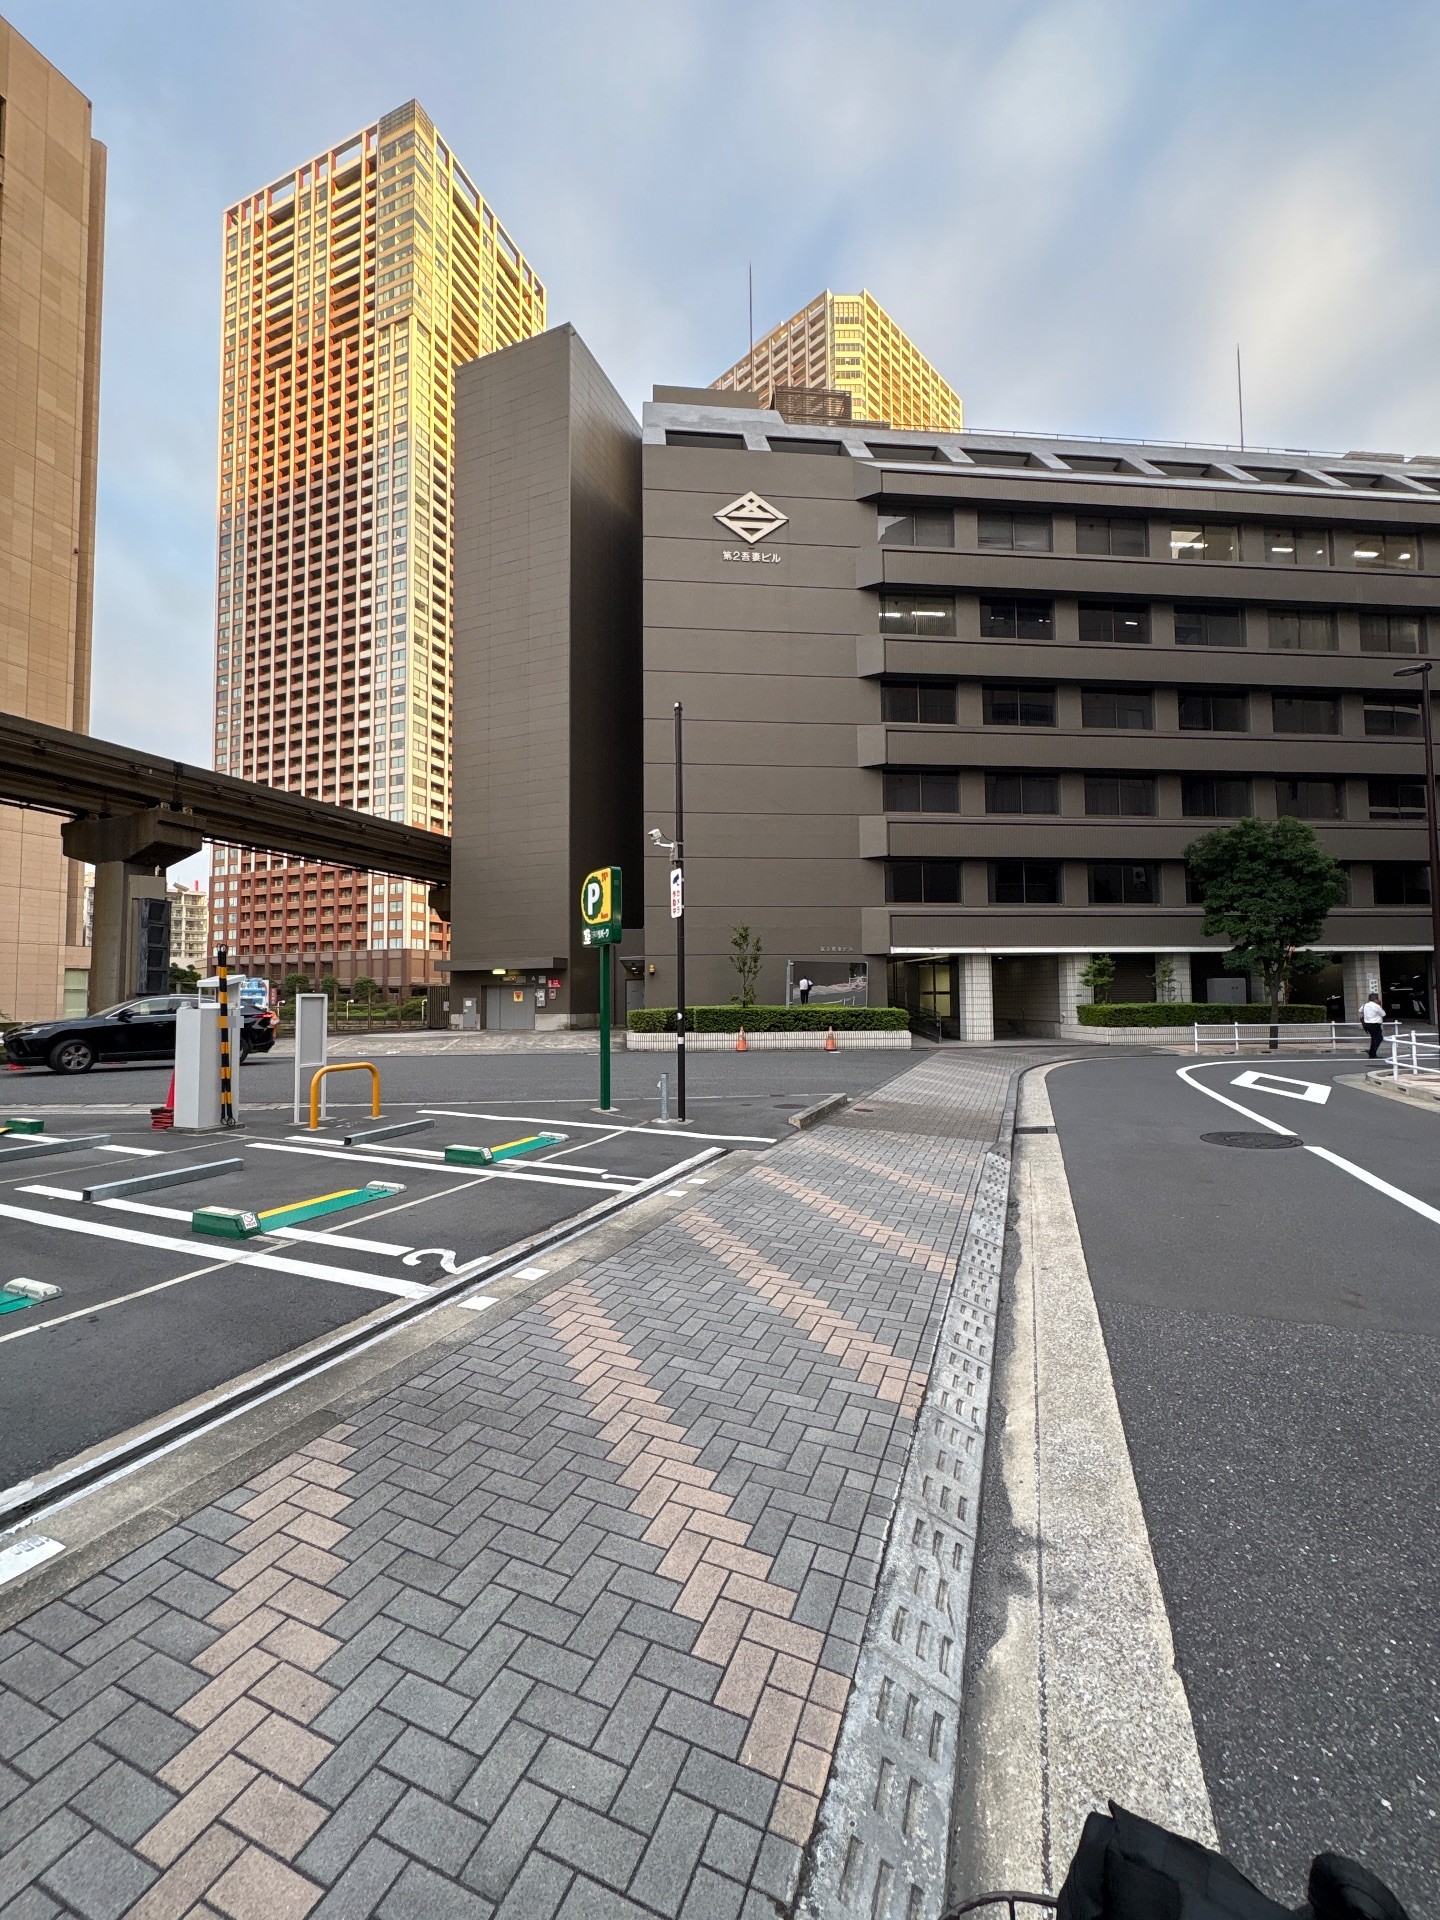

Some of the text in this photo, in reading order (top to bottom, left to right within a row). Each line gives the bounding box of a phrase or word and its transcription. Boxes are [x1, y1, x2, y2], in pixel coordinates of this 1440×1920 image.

[722, 550, 781, 563] 第2吾妻ビル
[587, 882, 600, 916] P
[402, 1248, 493, 1275] 2
